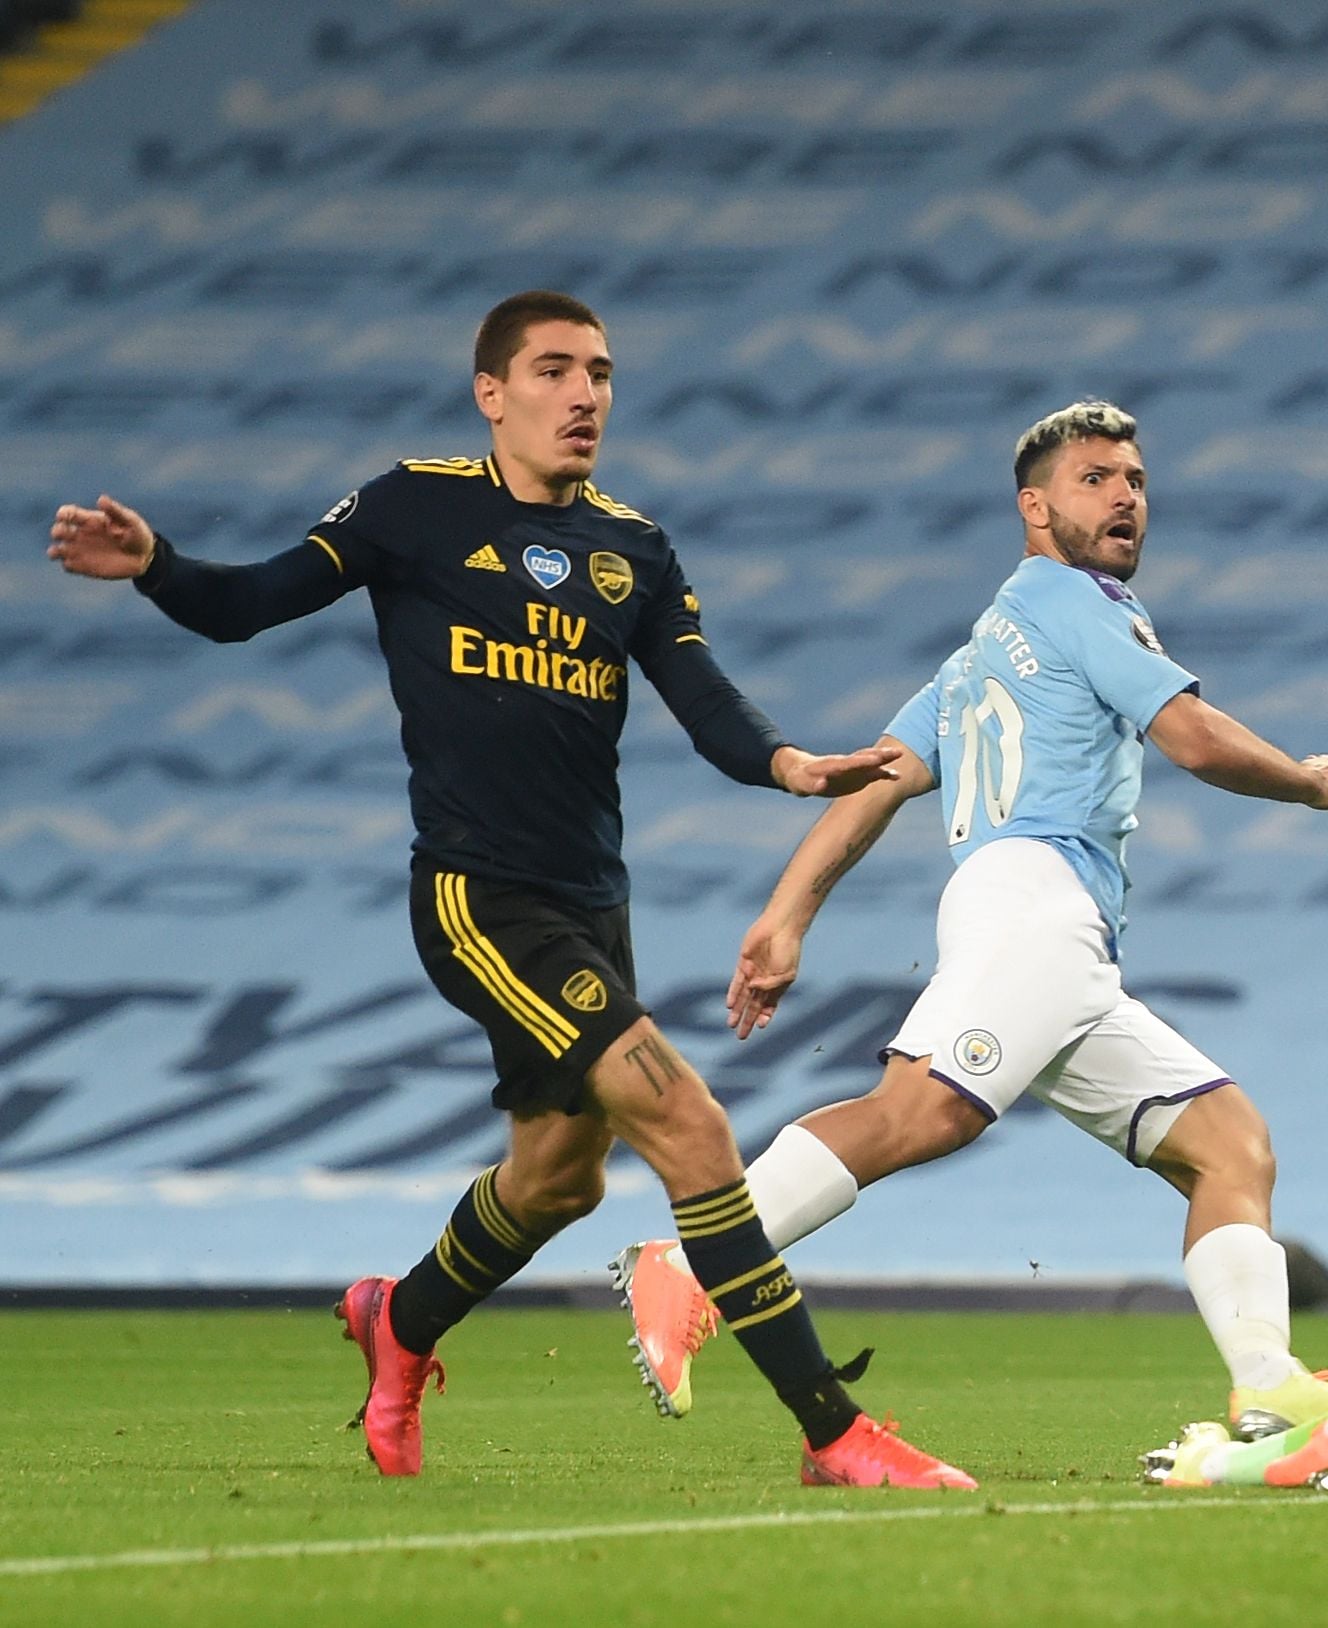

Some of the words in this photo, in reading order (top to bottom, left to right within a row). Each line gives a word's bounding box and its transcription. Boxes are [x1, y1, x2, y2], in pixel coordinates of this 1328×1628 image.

[532, 557, 561, 574] NHS
[525, 602, 588, 650] Fly
[948, 676, 1024, 848] 10
